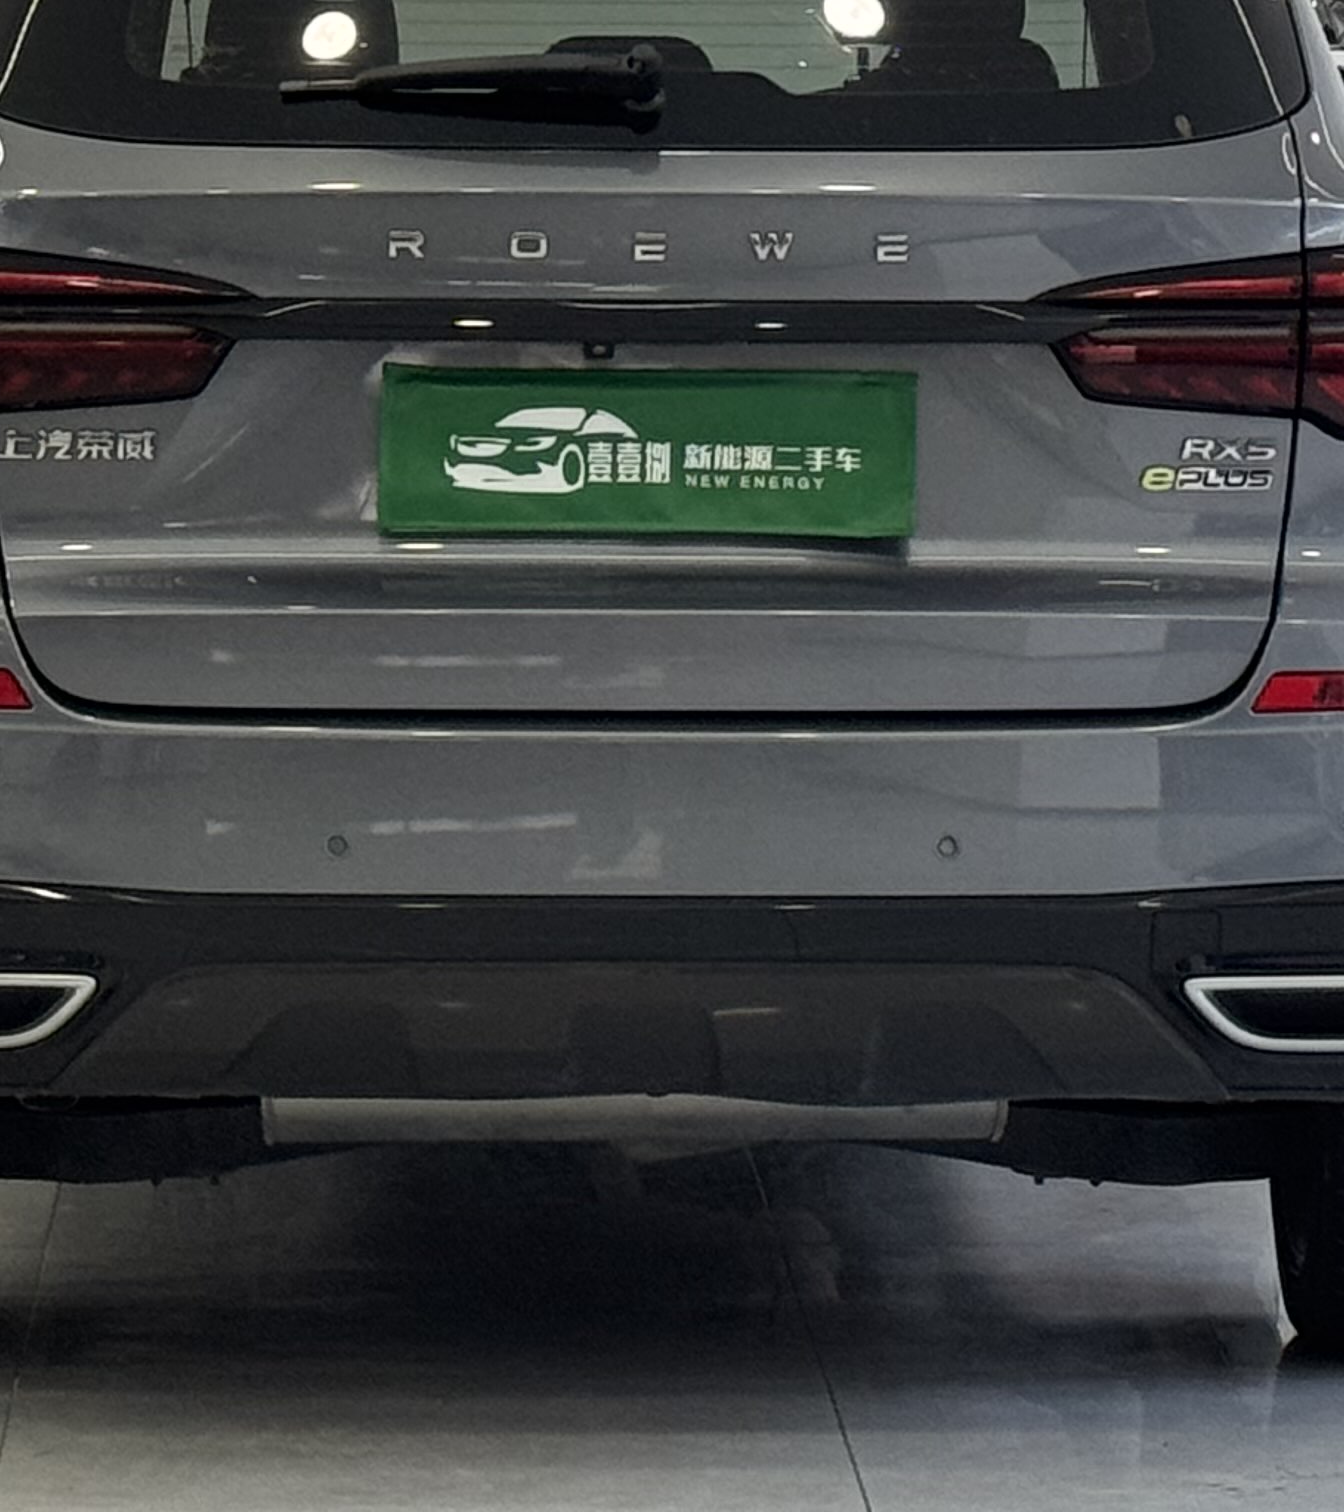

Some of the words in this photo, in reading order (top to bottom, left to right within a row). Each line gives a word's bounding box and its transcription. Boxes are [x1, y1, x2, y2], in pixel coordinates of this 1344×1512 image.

[387, 229, 910, 264] ROEWE
[587, 441, 672, 484] 壹壹捌
[682, 444, 863, 473] 新能源二手车
[1180, 437, 1278, 462] RX5
[684, 473, 731, 489] NEW
[739, 474, 826, 491] ENERGY
